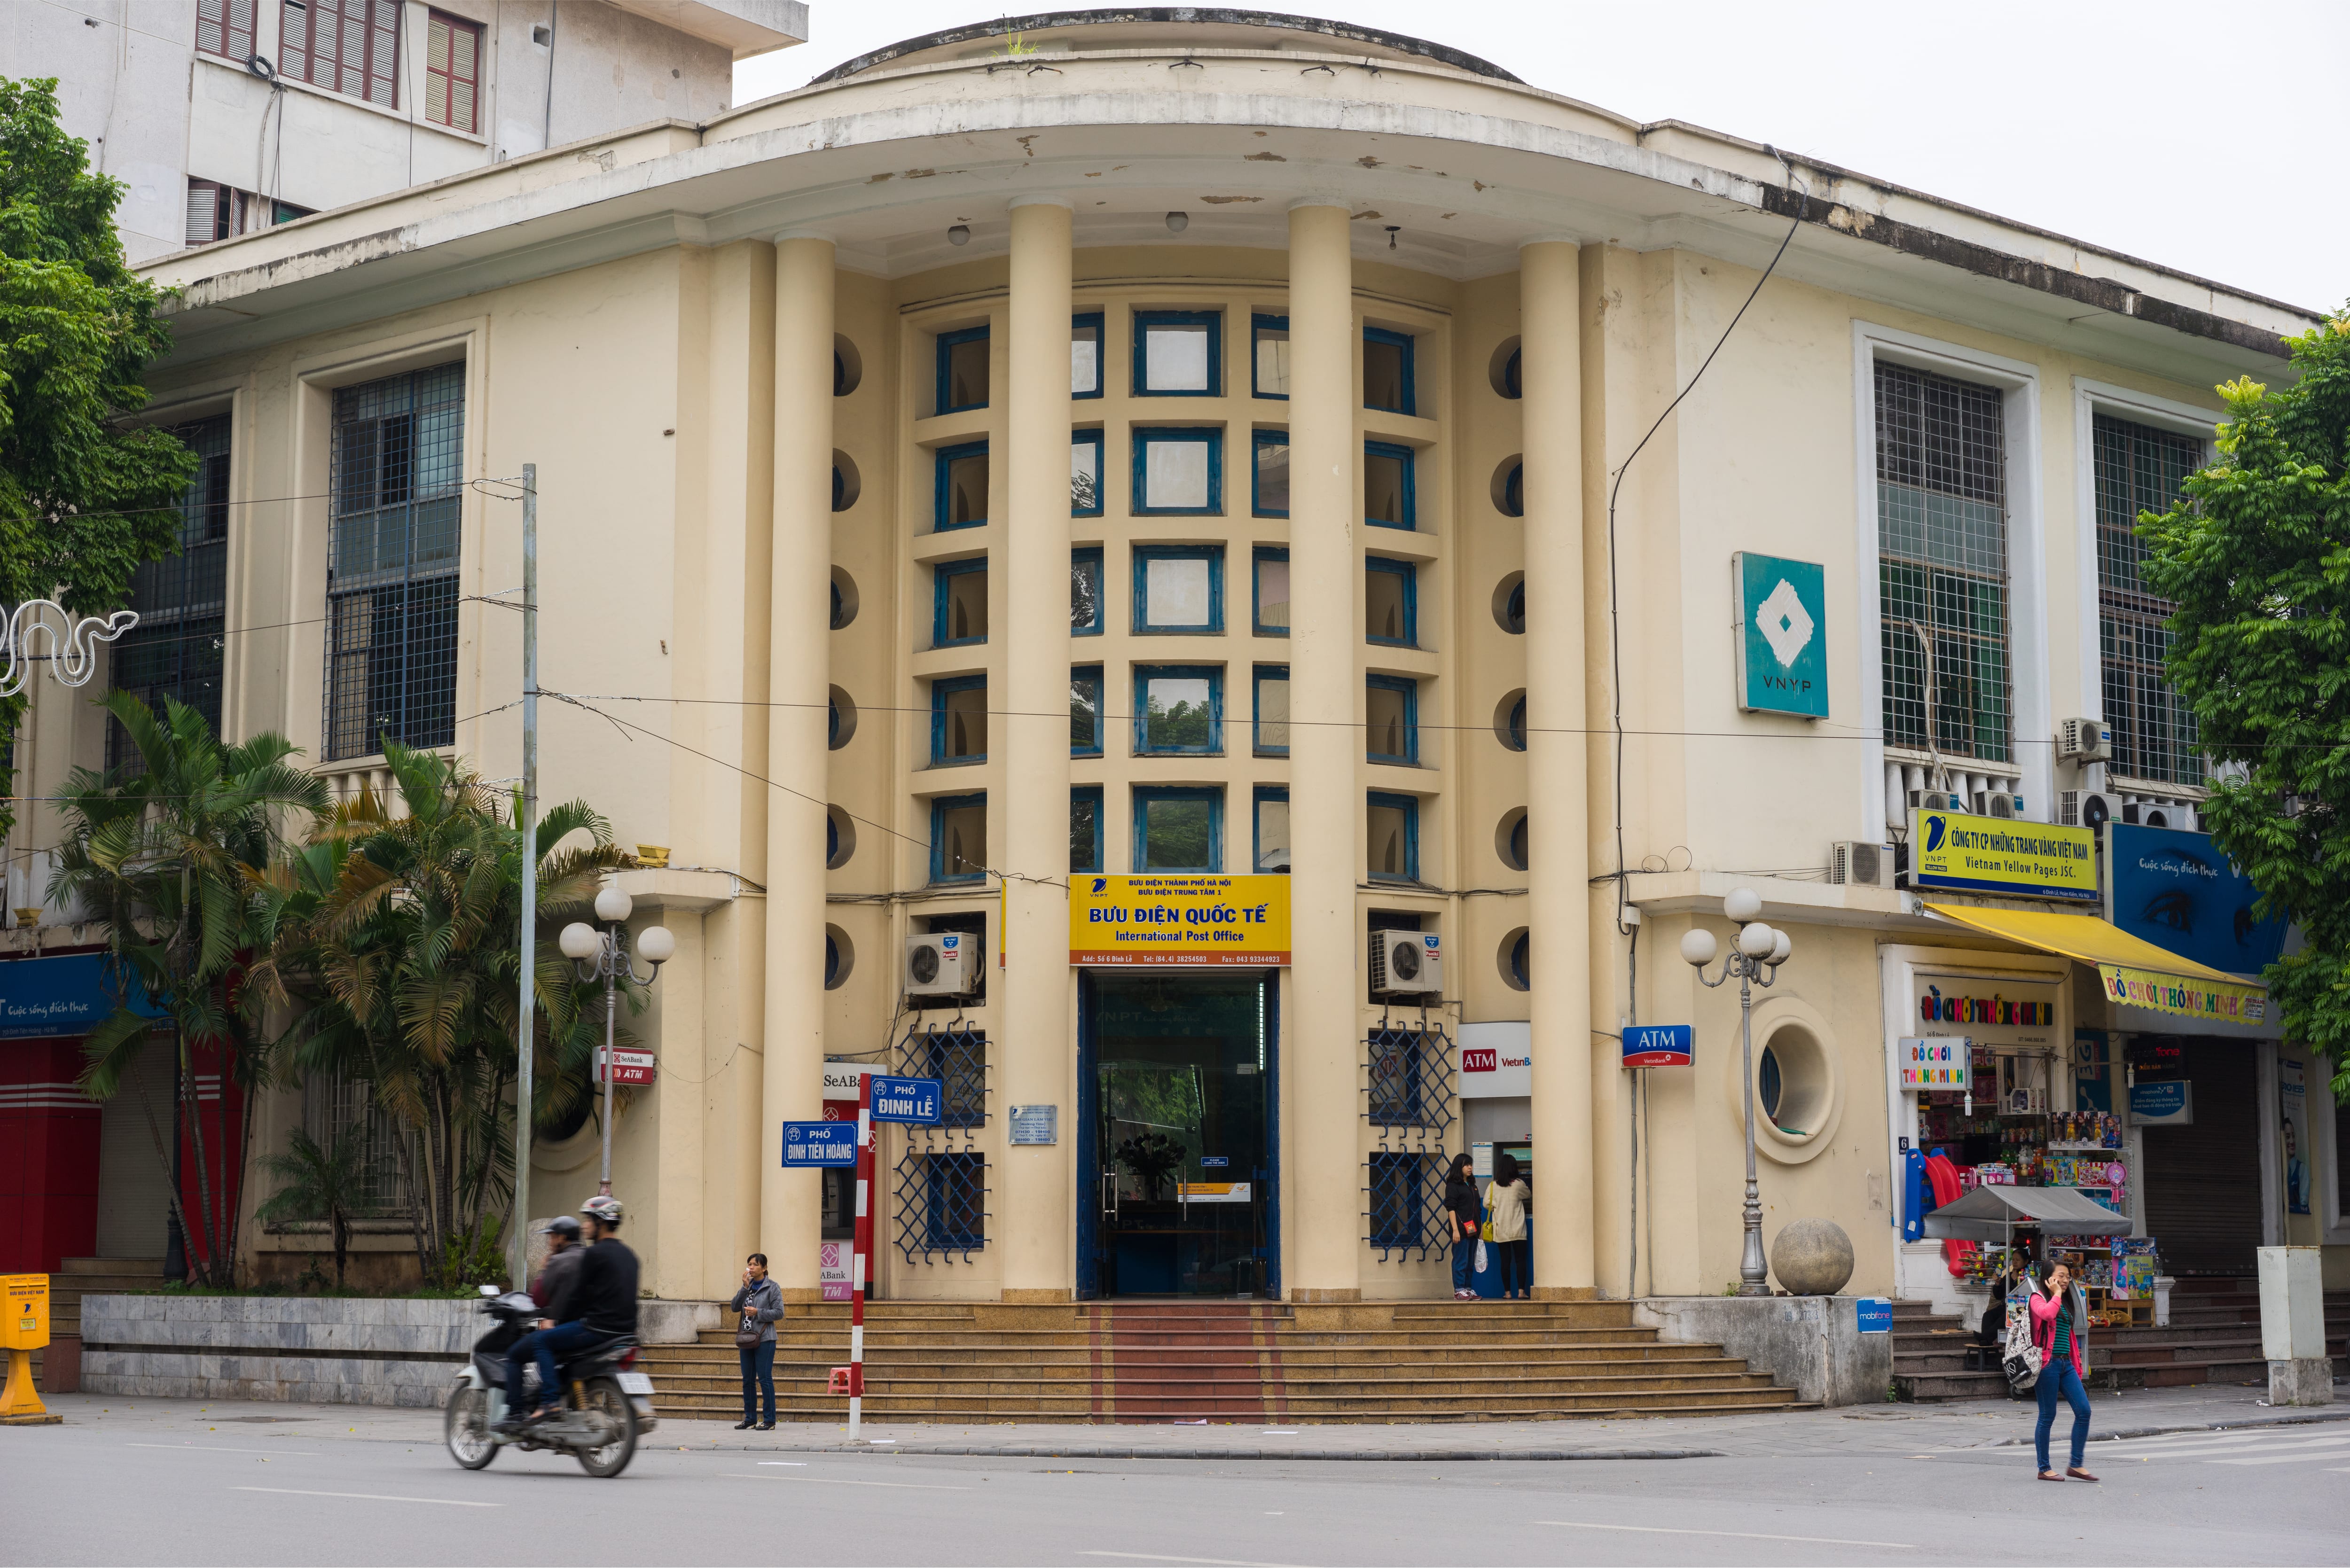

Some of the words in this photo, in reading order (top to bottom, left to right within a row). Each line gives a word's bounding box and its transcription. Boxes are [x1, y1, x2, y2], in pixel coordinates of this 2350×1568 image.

[1763, 675, 1811, 692] VNYP
[1951, 827, 1970, 848] CÔNG
[1971, 832, 1979, 849] TY
[1981, 833, 1989, 850] CP
[1990, 831, 2014, 853] NHỮNG
[2015, 836, 2037, 855] TRANG
[2038, 836, 2057, 857] VÀNG
[2057, 838, 2071, 863] VIỆT
[2073, 843, 2088, 860] NAM
[1966, 856, 2001, 871] Vietnam
[2004, 860, 2030, 873] Yellow
[2034, 863, 2058, 878] Pages
[2060, 866, 2076, 878] JSC.
[2139, 858, 2159, 872] Cuộc
[2161, 860, 2179, 877] sống
[2180, 860, 2199, 874] đích
[2200, 864, 2218, 879] thực
[1089, 906, 1128, 923] BƯU
[1134, 905, 1180, 926] ĐIỆN
[1185, 903, 1237, 926] QUỐC
[1242, 903, 1270, 923] TẾ
[1116, 930, 1182, 942] International
[1186, 931, 1209, 942] Post
[1213, 930, 1245, 942] Office
[2106, 968, 2126, 998] ĐỒ
[2129, 980, 2158, 1004] CHƠI
[2160, 983, 2202, 1011] THÔNG
[2205, 993, 2238, 1016] MINH
[9, 1005, 28, 1015] Cuộc
[30, 1004, 48, 1018] sống
[50, 1000, 69, 1013] đích
[70, 1000, 90, 1014] thực
[1920, 985, 1942, 1021] ĐỒ
[1943, 995, 1975, 1023] CHƠI
[1976, 994, 2020, 1025] THÔNG
[2021, 1002, 2052, 1026] MINH
[1638, 1030, 1676, 1047] ATM
[1911, 1040, 1925, 1061] ĐỒ
[1927, 1045, 1951, 1061] CHƠI
[1465, 1053, 1495, 1068] ATM
[1501, 1057, 1531, 1067] VietinB
[623, 1069, 643, 1079] ATM
[1903, 1065, 1936, 1083] THÔNG
[1939, 1069, 1963, 1083] MINH
[895, 1084, 916, 1095] PHỐ
[878, 1099, 913, 1115] ĐINH
[917, 1095, 933, 1116] LỄ
[809, 1127, 832, 1139] PHỐ
[788, 1144, 806, 1159] ĐINH
[808, 1141, 824, 1159] TIÊN
[826, 1140, 852, 1159] HOÀNG
[1901, 1138, 1907, 1148] 6
[824, 1287, 843, 1297] TM
[1860, 1311, 1890, 1319] mobifone
